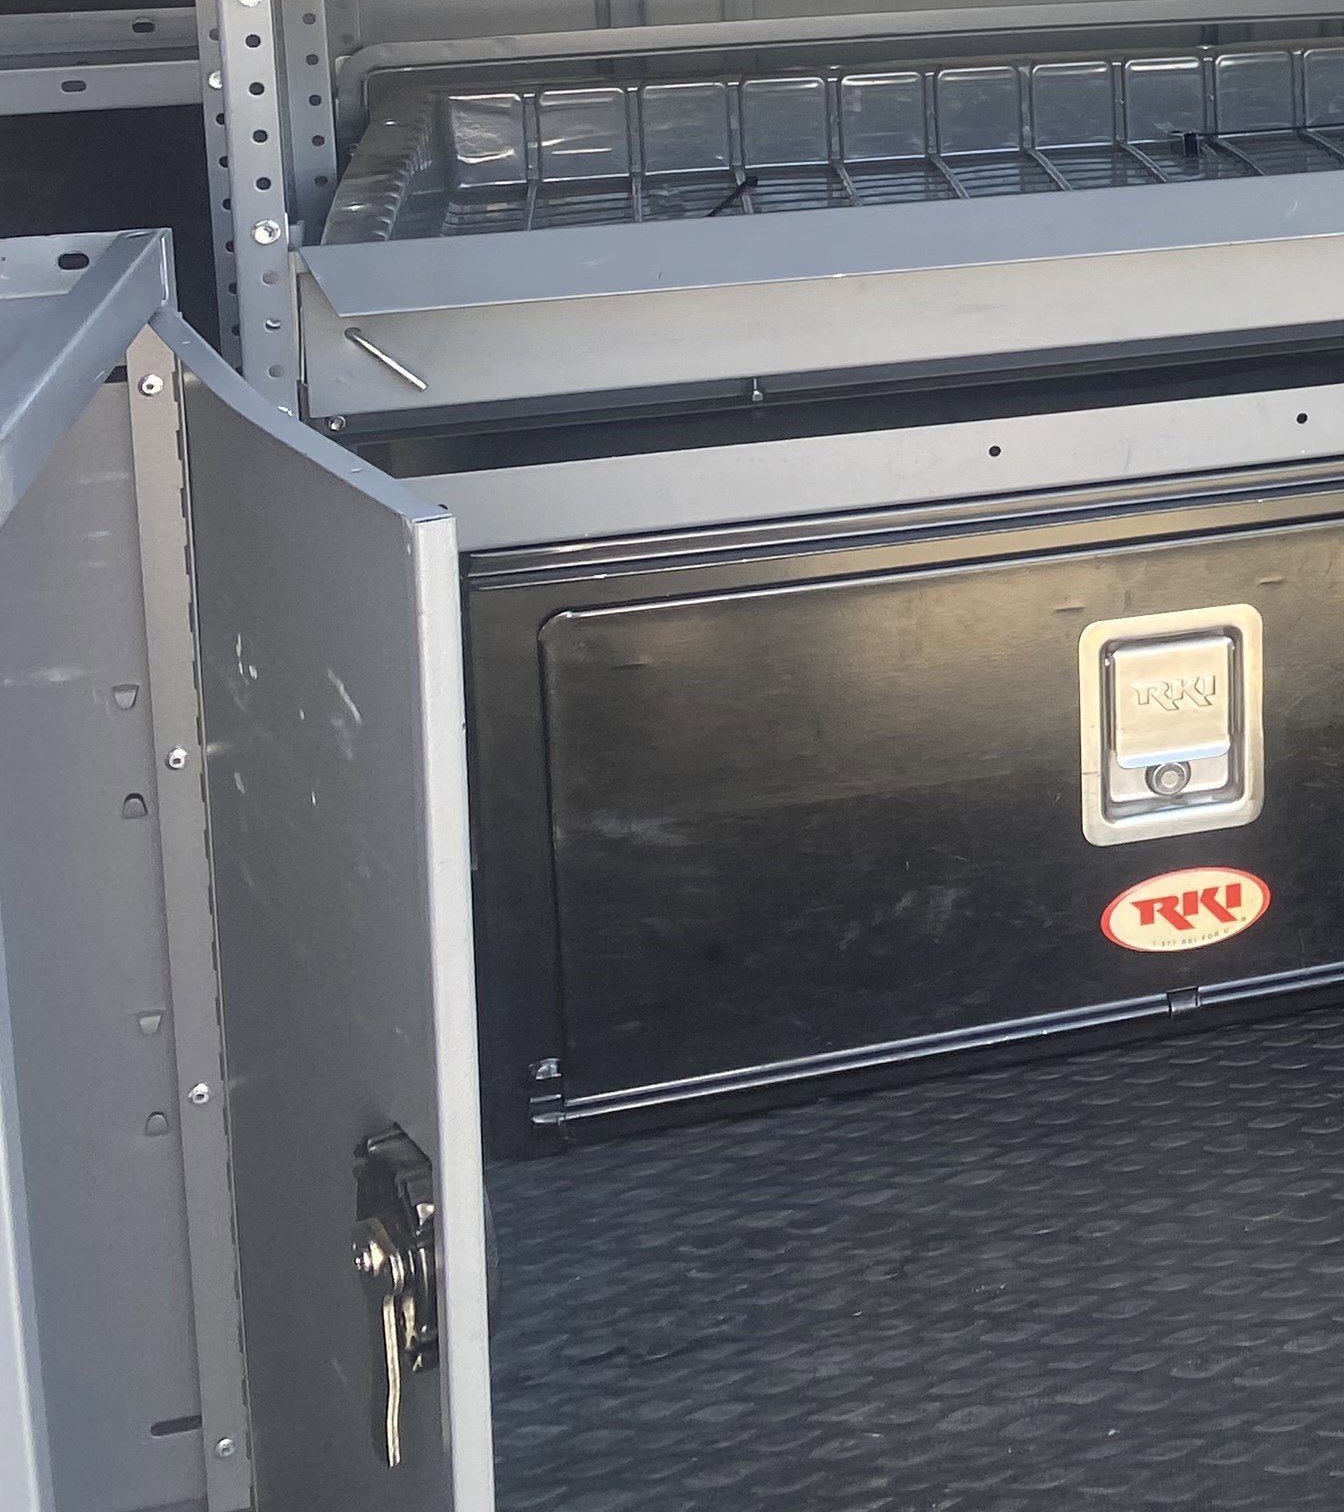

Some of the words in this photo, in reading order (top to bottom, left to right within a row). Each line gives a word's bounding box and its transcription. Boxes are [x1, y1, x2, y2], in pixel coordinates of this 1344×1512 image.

[1131, 675, 1216, 711] RKI
[1130, 882, 1242, 931] RKI
[1201, 931, 1220, 941] FOR
